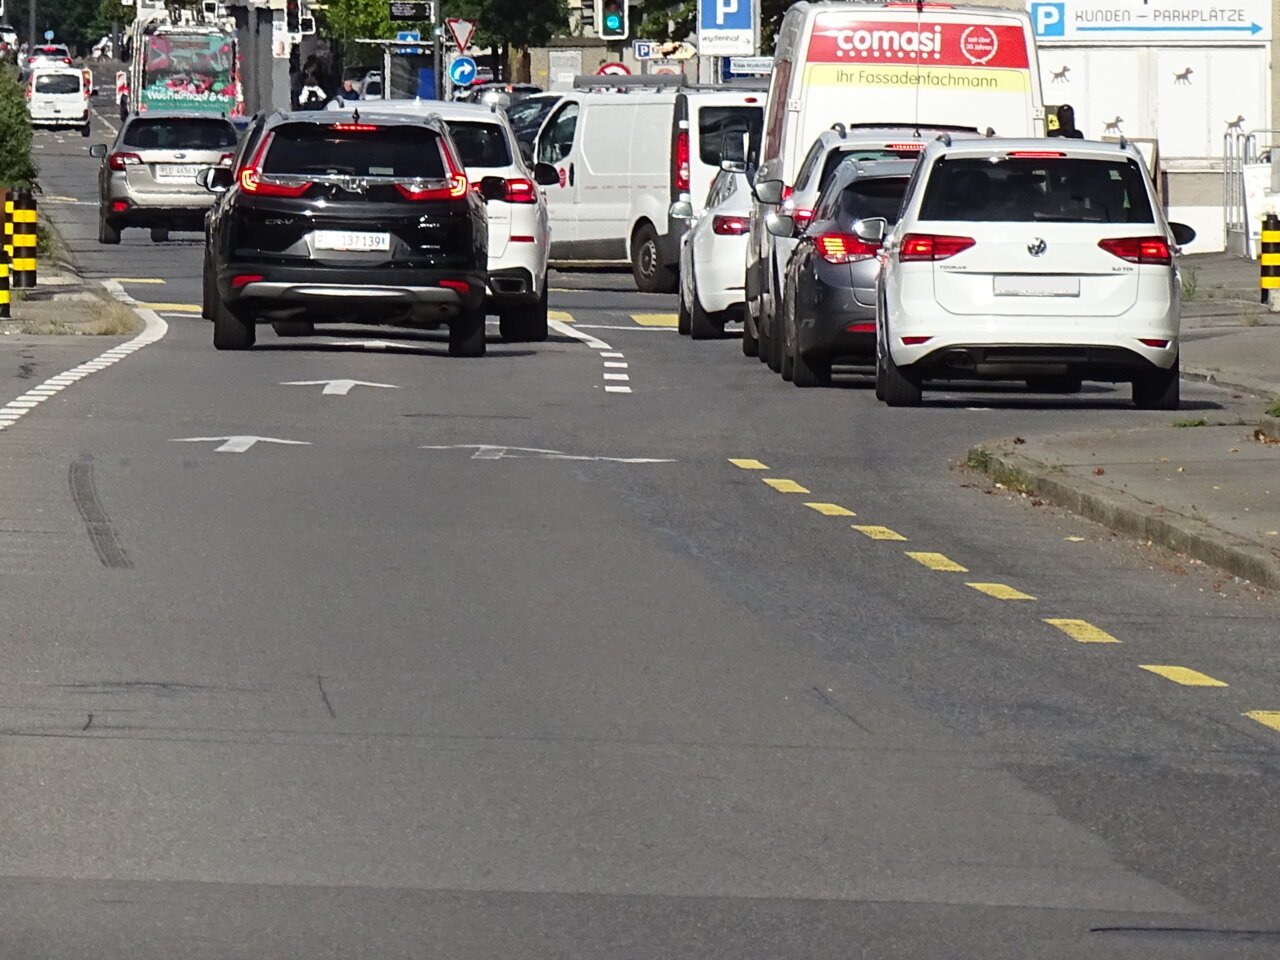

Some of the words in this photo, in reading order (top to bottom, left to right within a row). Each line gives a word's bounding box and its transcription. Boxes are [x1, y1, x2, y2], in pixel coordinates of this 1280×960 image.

[1037, 6, 1060, 35] P
[1075, 9, 1131, 22] KUNDEN
[1153, 7, 1245, 22] PARKPLÄTZE
[836, 25, 941, 52] comasi
[640, 46, 650, 57] P
[836, 70, 854, 83] Ihr
[859, 72, 998, 88] Fassadenfachmann
